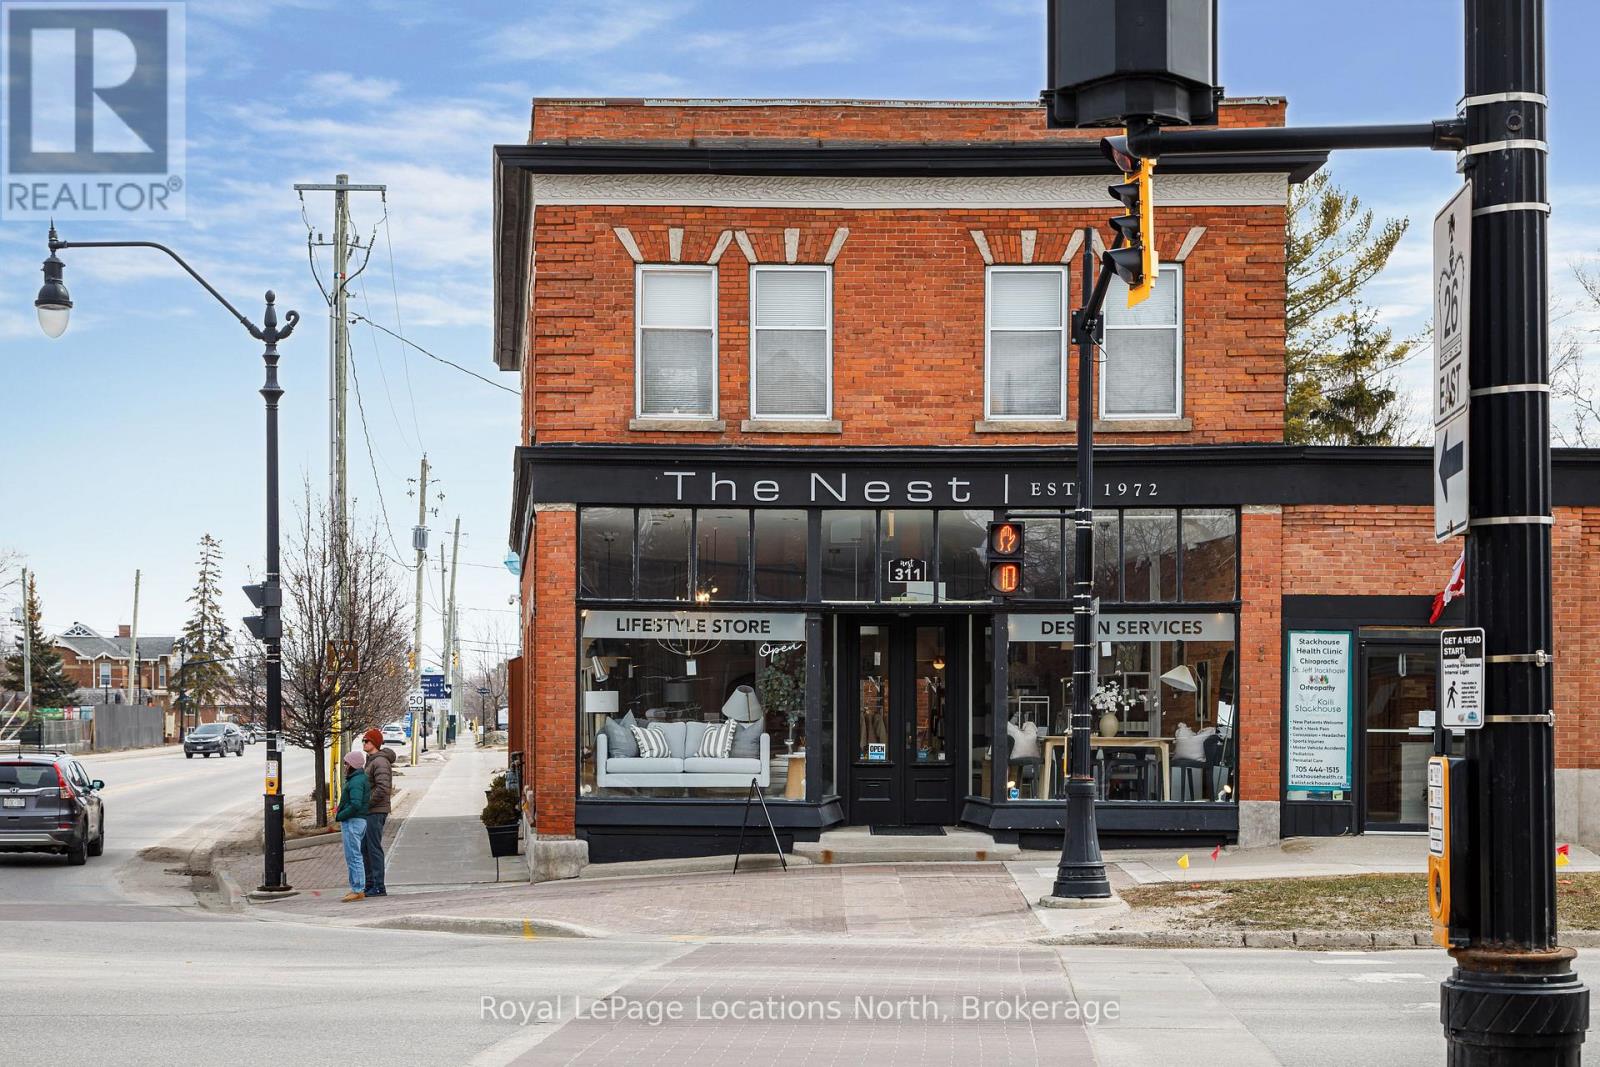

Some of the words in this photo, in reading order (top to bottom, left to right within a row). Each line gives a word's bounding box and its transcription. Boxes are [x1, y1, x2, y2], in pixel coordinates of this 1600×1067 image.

[1443, 277, 1459, 340] 26
[1439, 362, 1462, 417] EAST
[664, 470, 780, 503] The
[810, 470, 972, 503] Nest
[1103, 482, 1158, 497] 1972
[894, 568, 922, 581] 311
[1002, 565, 1016, 590] 10
[616, 616, 706, 634] LIFESTYLE
[711, 616, 771, 634] STORE
[1041, 620, 1110, 635] DESN
[1116, 620, 1204, 635] SERVICES
[1443, 637, 1457, 645] GET
[1463, 635, 1481, 644] HEAD
[758, 642, 803, 663] Open
[410, 696, 423, 704] 50
[869, 745, 885, 753] OPEN
[1295, 765, 1307, 773] 705
